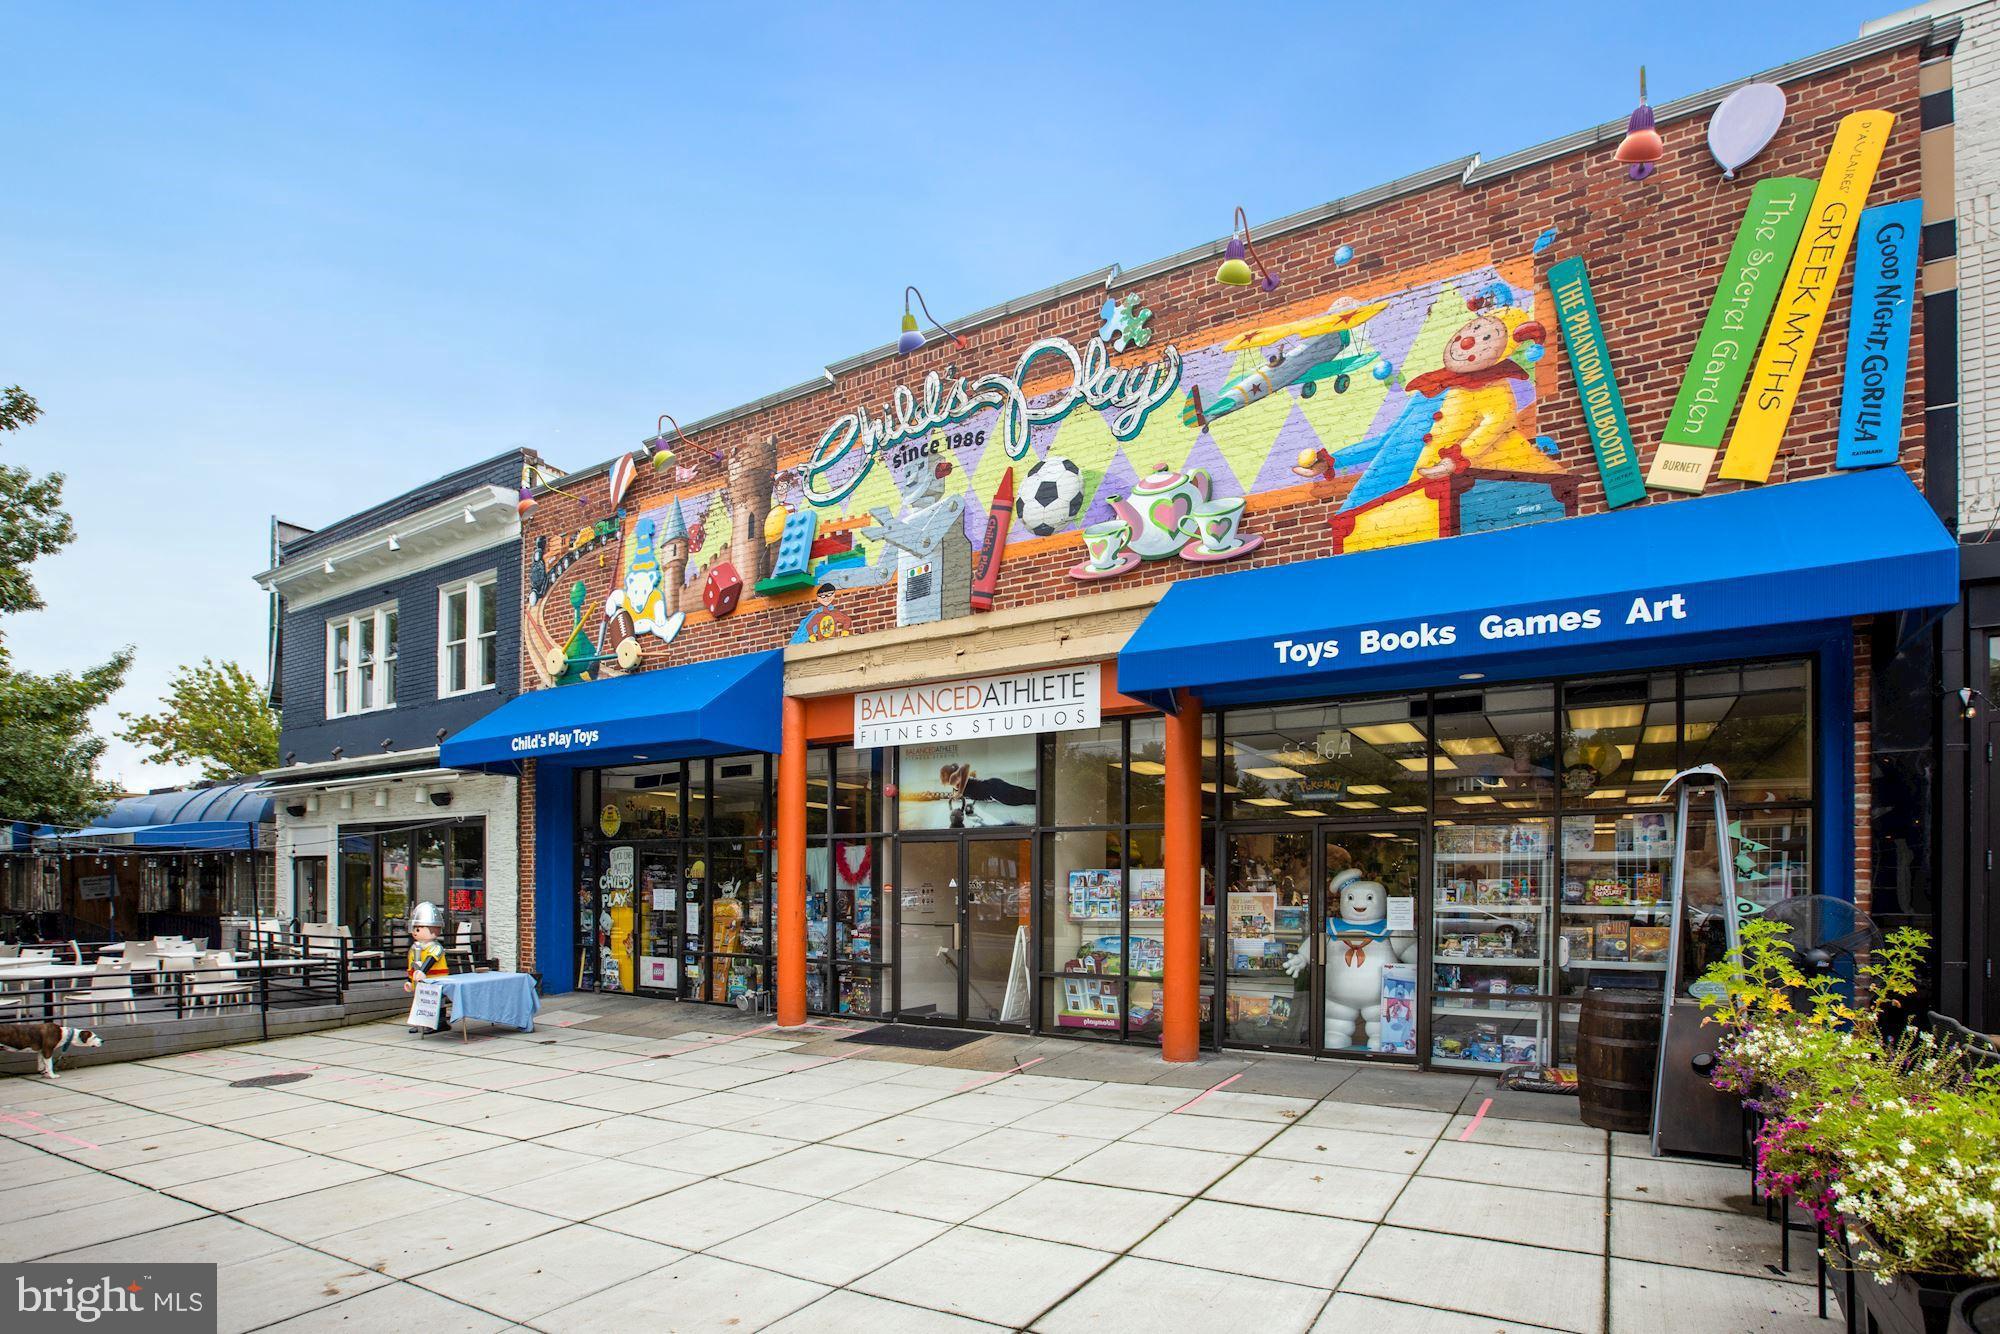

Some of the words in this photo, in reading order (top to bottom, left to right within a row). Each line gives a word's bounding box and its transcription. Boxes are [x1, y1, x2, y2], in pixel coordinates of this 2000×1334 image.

[1755, 192, 1797, 242] The
[1795, 202, 1849, 305] GREEK
[1557, 276, 1584, 313] THE
[1720, 248, 1775, 332] Secret
[1565, 308, 1596, 384] PHANTOM
[1758, 312, 1811, 411] MYTHS
[797, 364, 1003, 507] Child's
[972, 336, 1183, 460] Play
[1585, 377, 1629, 469] TOLLBOOTH
[1683, 339, 1740, 434] Garden
[1854, 355, 1889, 442] GORILLA
[892, 440, 940, 469] since
[945, 430, 986, 453] 1986
[1662, 460, 1702, 474] BURNETT
[1273, 637, 1340, 668] Toys
[1360, 623, 1456, 655] Books
[1479, 606, 1602, 641] Games
[1625, 594, 1688, 625] Art
[860, 722, 954, 744] FITNESS
[972, 709, 1086, 733] STUDIOS
[861, 671, 1085, 721] BALANCEDATHLETE
[511, 733, 547, 752] Child's
[548, 731, 572, 749] Play
[573, 728, 599, 747] Toys
[1083, 1018, 1115, 1026] playmobil
